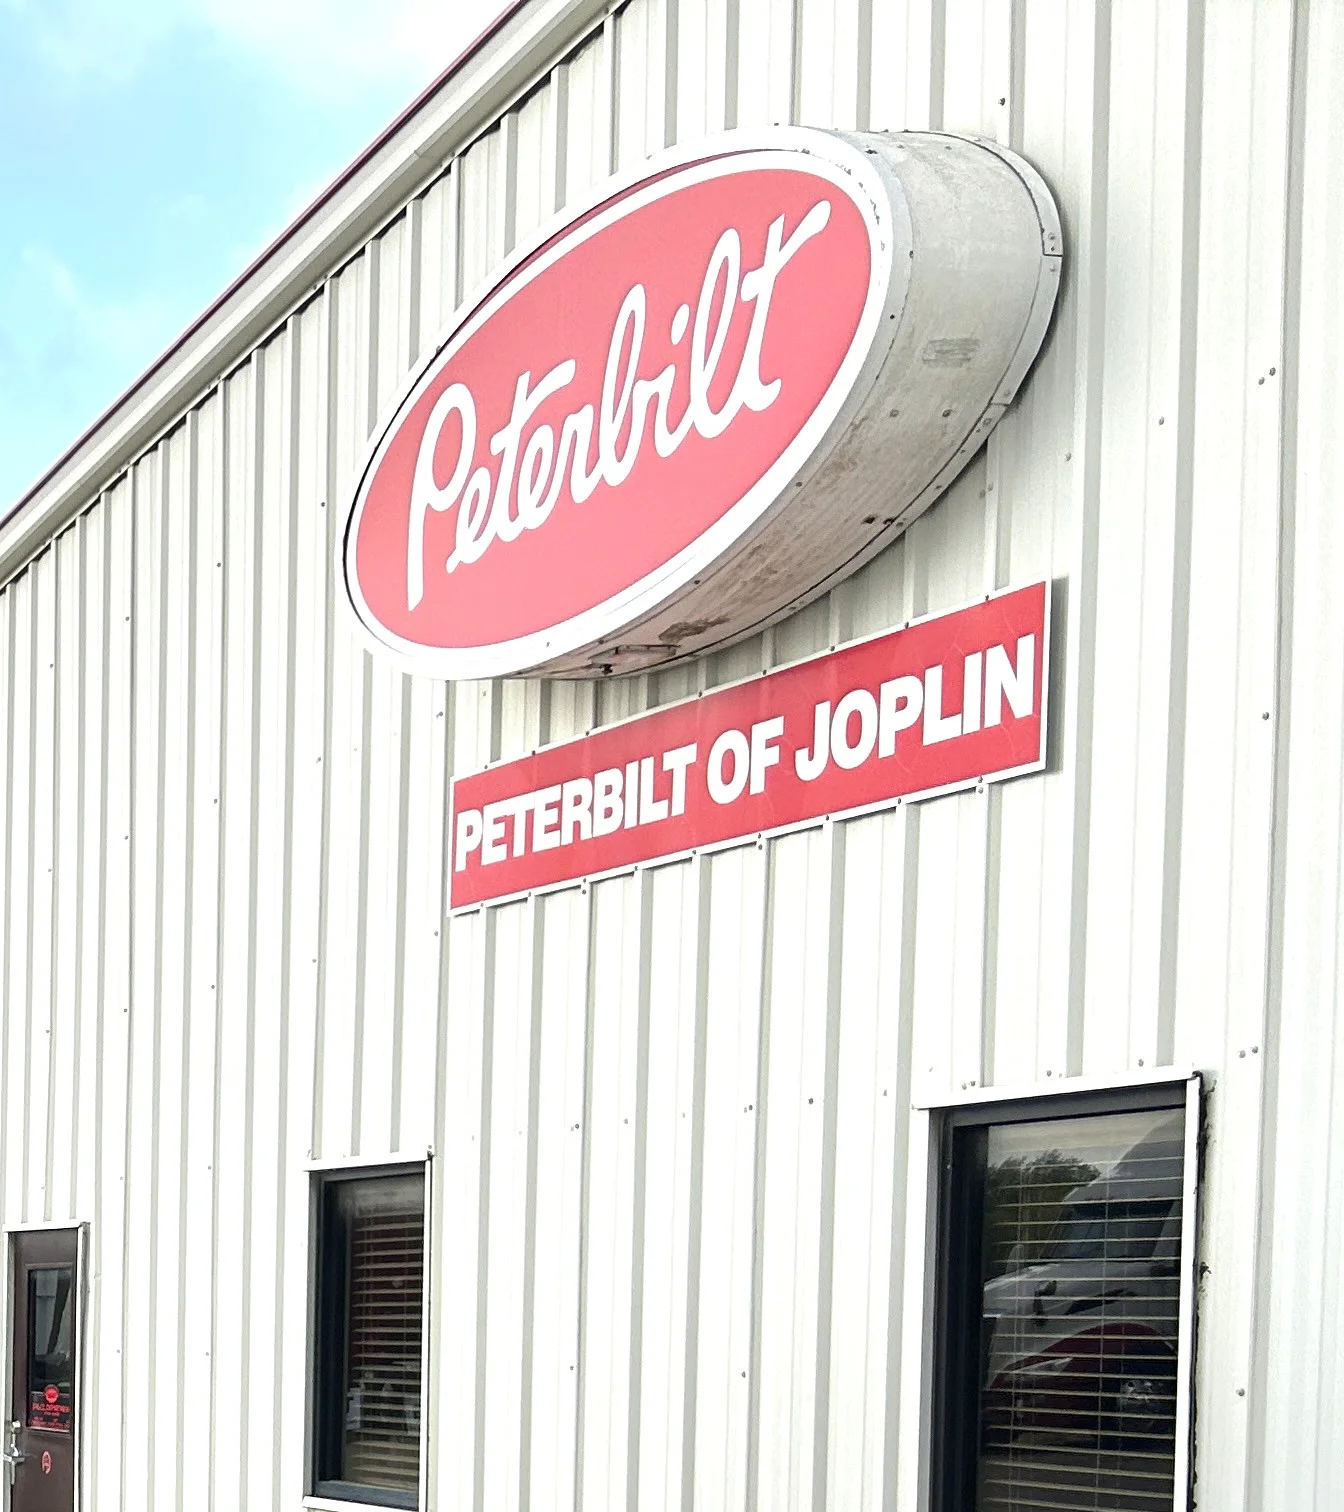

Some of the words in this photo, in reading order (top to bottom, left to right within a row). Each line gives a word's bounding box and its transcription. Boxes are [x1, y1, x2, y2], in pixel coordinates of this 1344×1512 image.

[407, 200, 832, 612] Peterbilt
[454, 742, 699, 873] PETERBILT
[707, 715, 785, 805] OF
[795, 633, 1035, 782] JOPLIN
